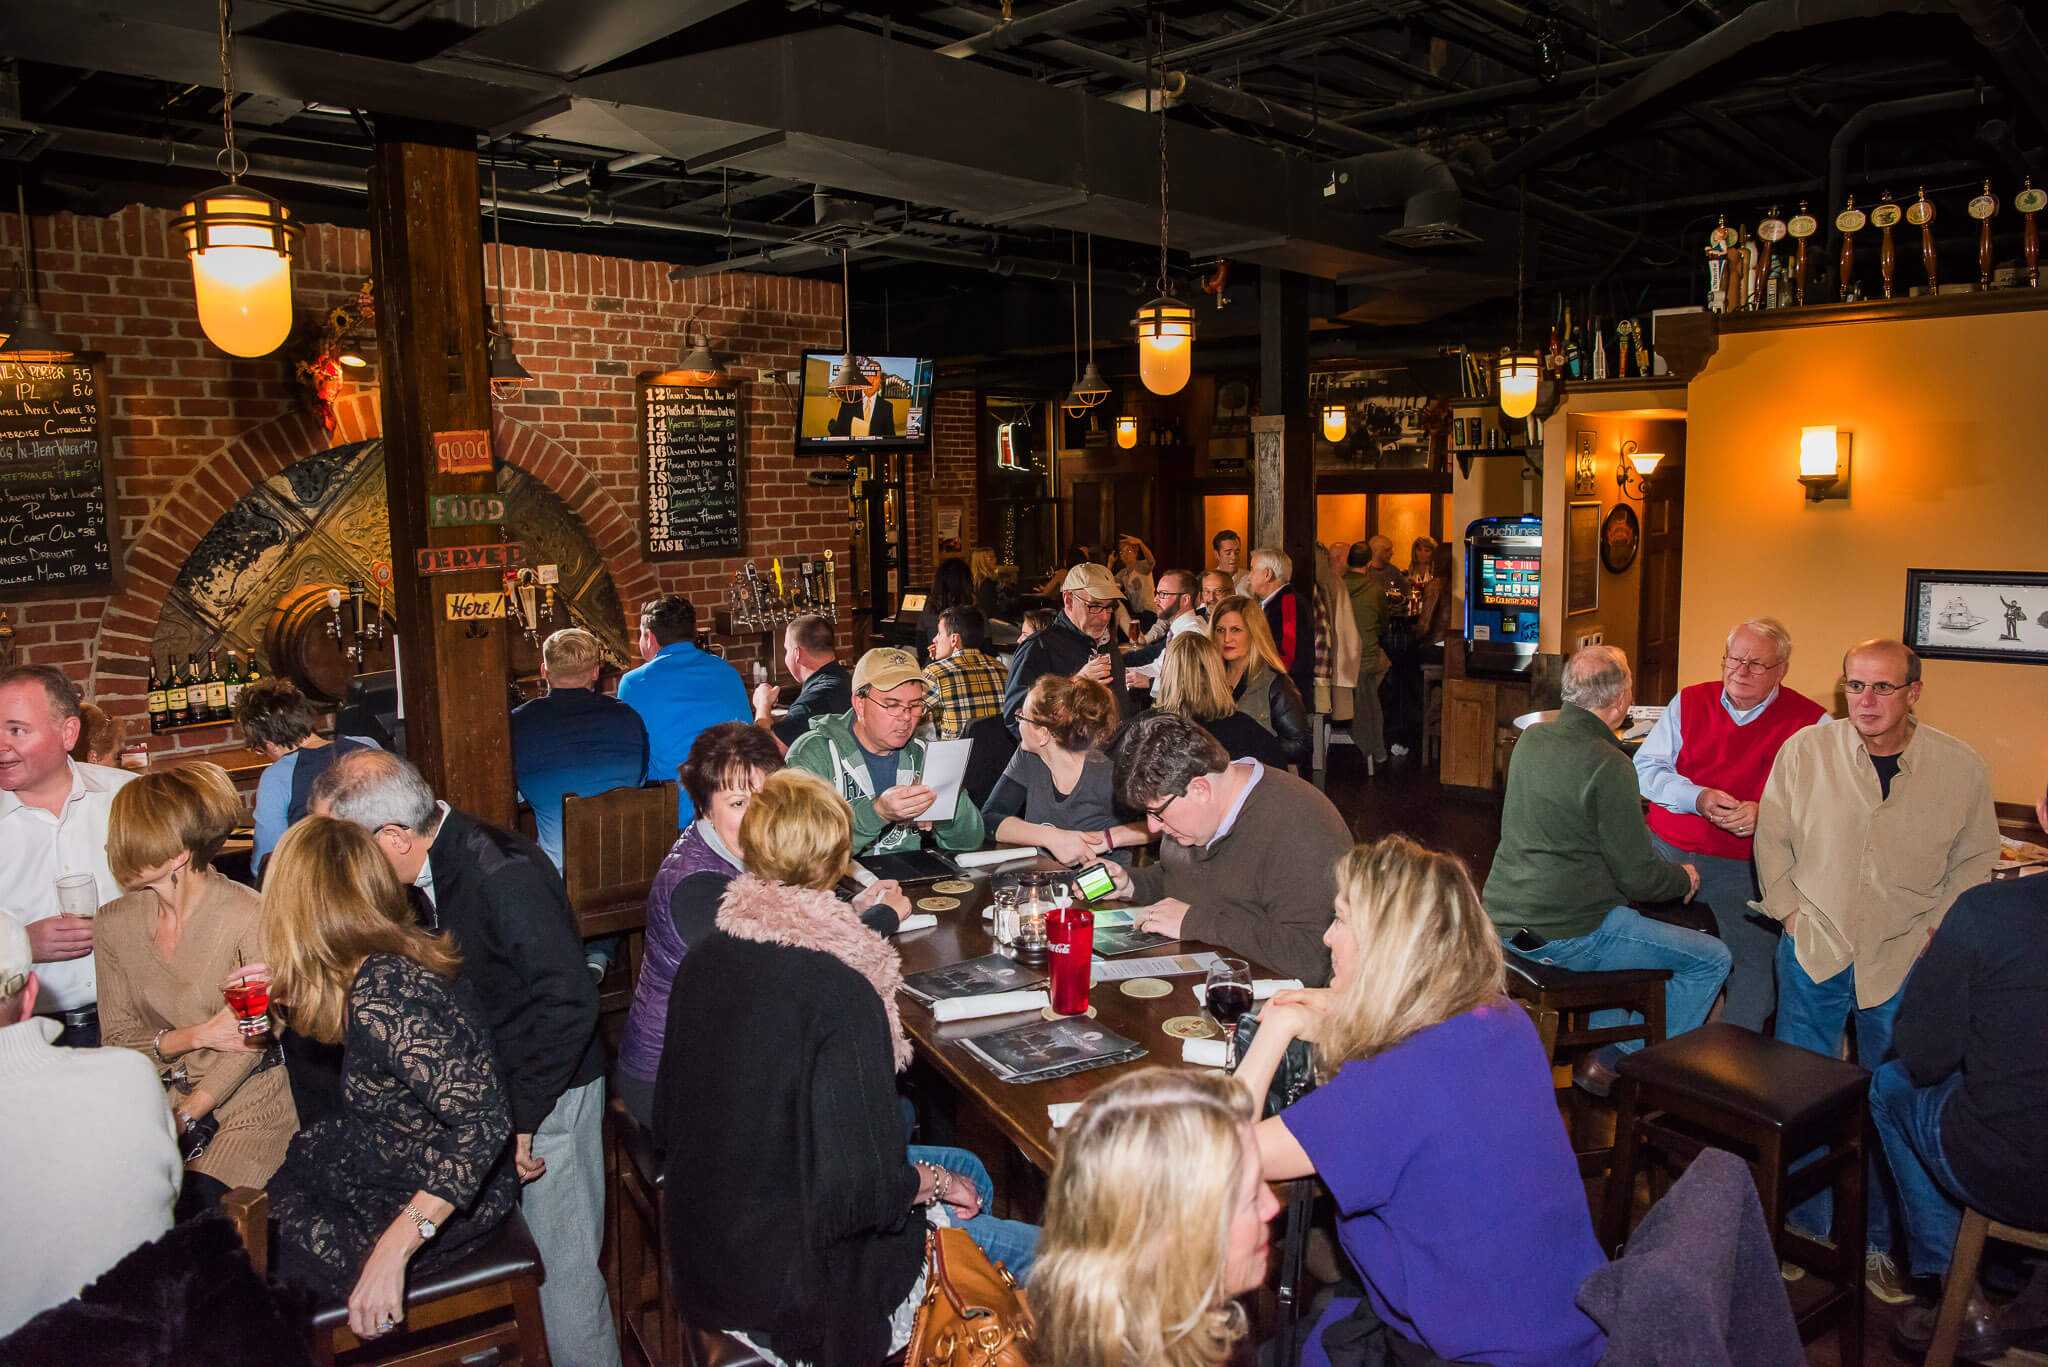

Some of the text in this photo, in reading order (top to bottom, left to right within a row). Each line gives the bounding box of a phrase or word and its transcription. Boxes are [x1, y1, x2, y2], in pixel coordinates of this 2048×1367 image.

[16, 383, 40, 400] IPL
[646, 387, 666, 401] 12
[647, 403, 666, 418] 13
[647, 418, 667, 431] 14
[647, 432, 666, 444] 15
[438, 430, 489, 471] good
[648, 444, 667, 457] 16
[648, 458, 667, 471] 17
[648, 471, 668, 484] 18
[648, 484, 668, 498] 19
[435, 498, 505, 521] FOOD
[649, 498, 668, 511] 20
[649, 511, 669, 526] 21
[9, 523, 47, 545] COAST
[48, 524, 76, 541] OLD
[650, 526, 669, 539] 22
[1481, 525, 1540, 537] TouchTunes
[650, 539, 685, 553] CASK
[419, 545, 527, 569] SERVED
